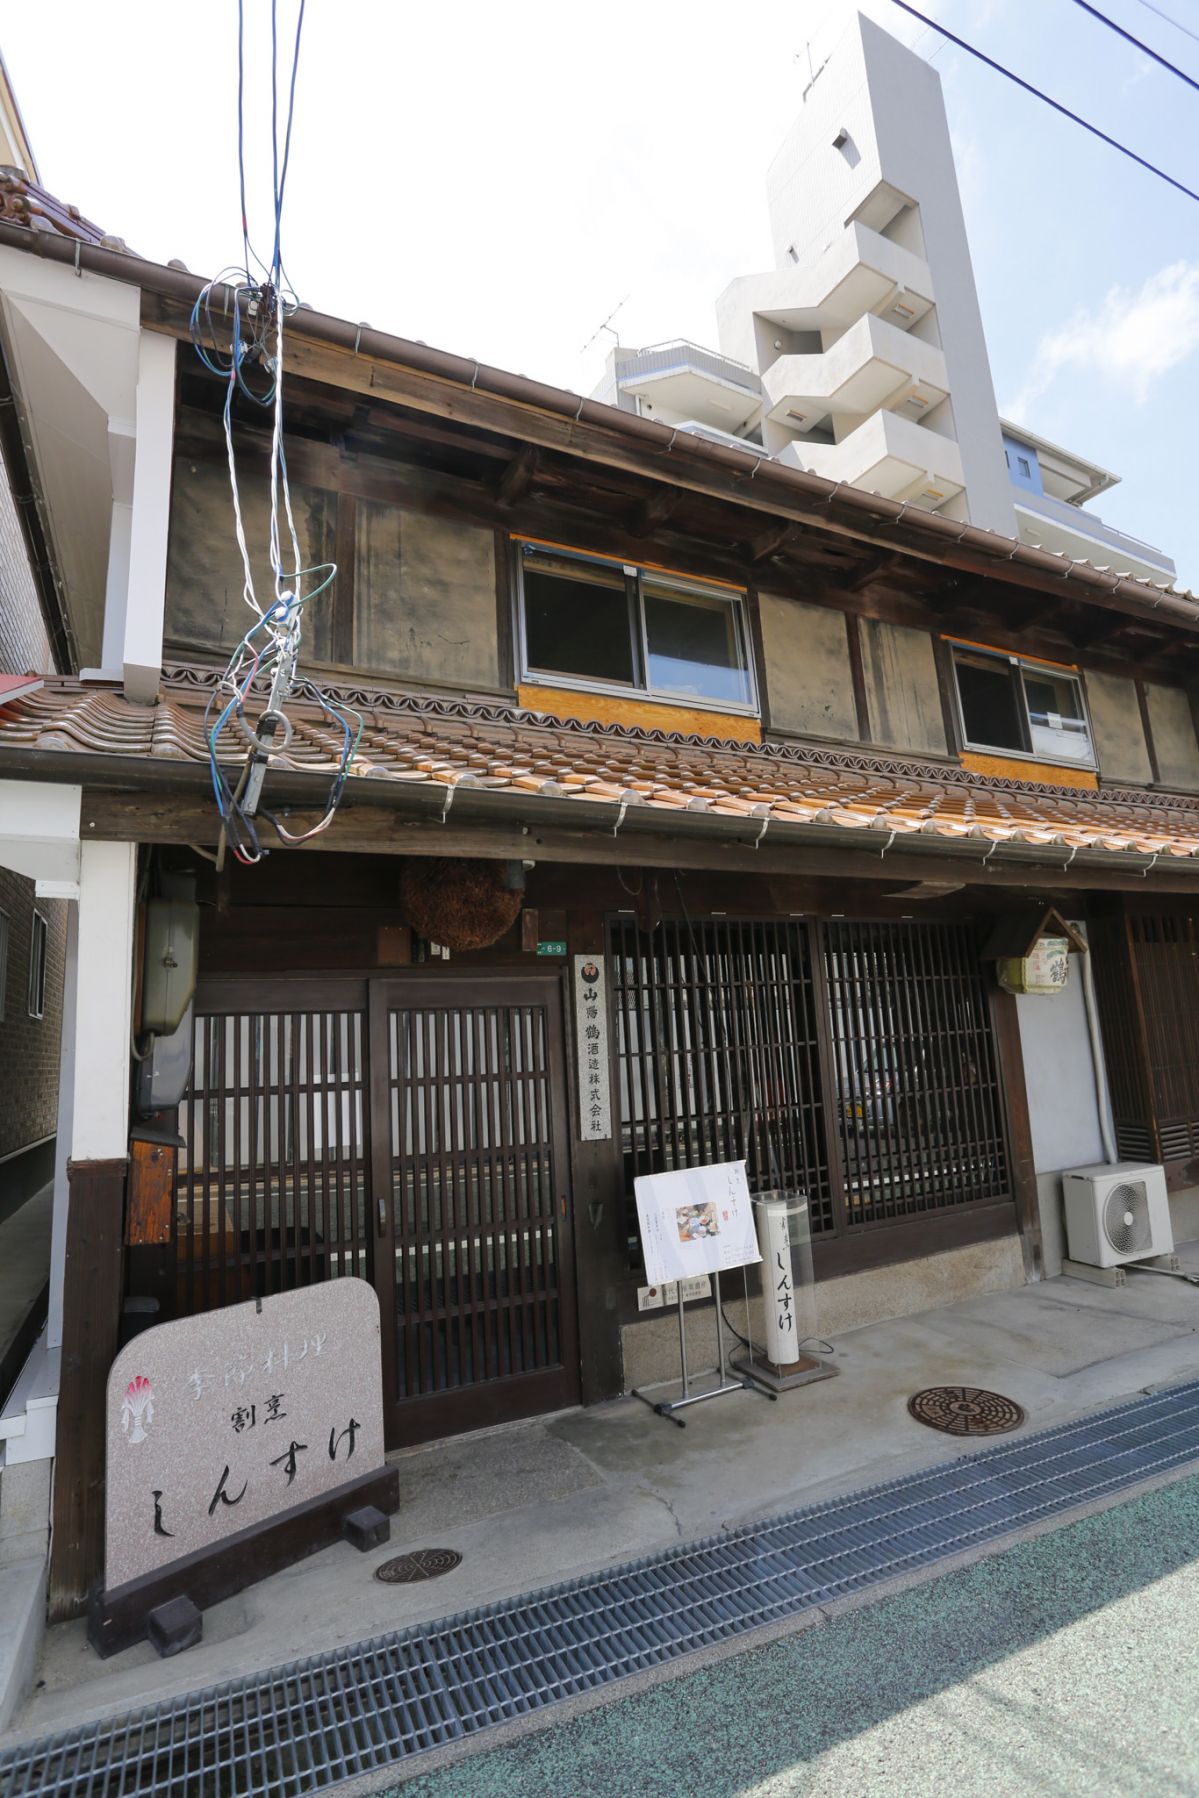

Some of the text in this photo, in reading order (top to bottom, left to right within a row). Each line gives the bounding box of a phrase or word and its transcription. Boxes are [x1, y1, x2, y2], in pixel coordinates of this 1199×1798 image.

[547, 944, 562, 953] 6-9
[583, 987, 603, 1132] 山陽鶴酒造株式会社
[777, 1252, 793, 1332] しんすけ
[151, 1417, 361, 1538] しんすけ
